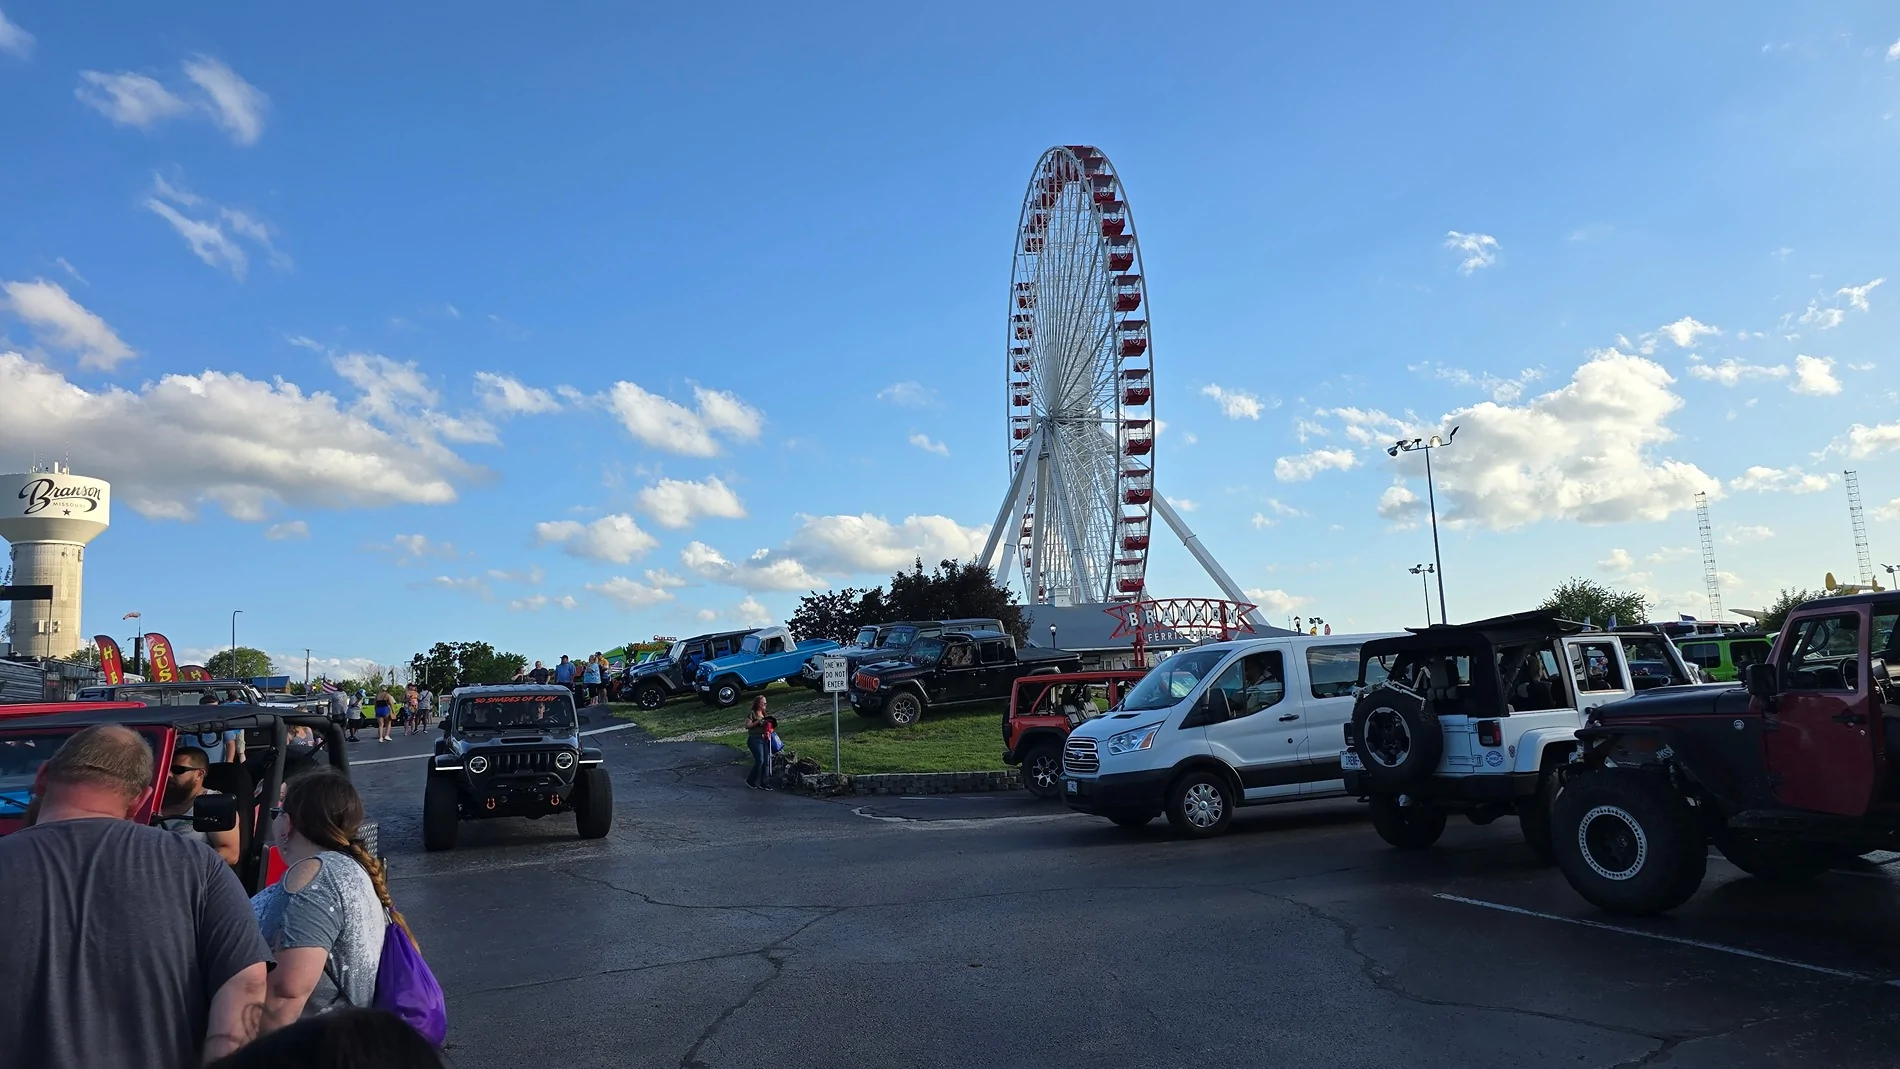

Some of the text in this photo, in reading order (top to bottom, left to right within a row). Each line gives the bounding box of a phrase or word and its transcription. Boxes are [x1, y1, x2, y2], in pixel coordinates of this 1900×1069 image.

[18, 478, 101, 514] Branson
[1128, 605, 1237, 627] BRANSON
[1147, 631, 1184, 643] FERRIS
[152, 642, 173, 682] SUS
[825, 671, 833, 679] DO
